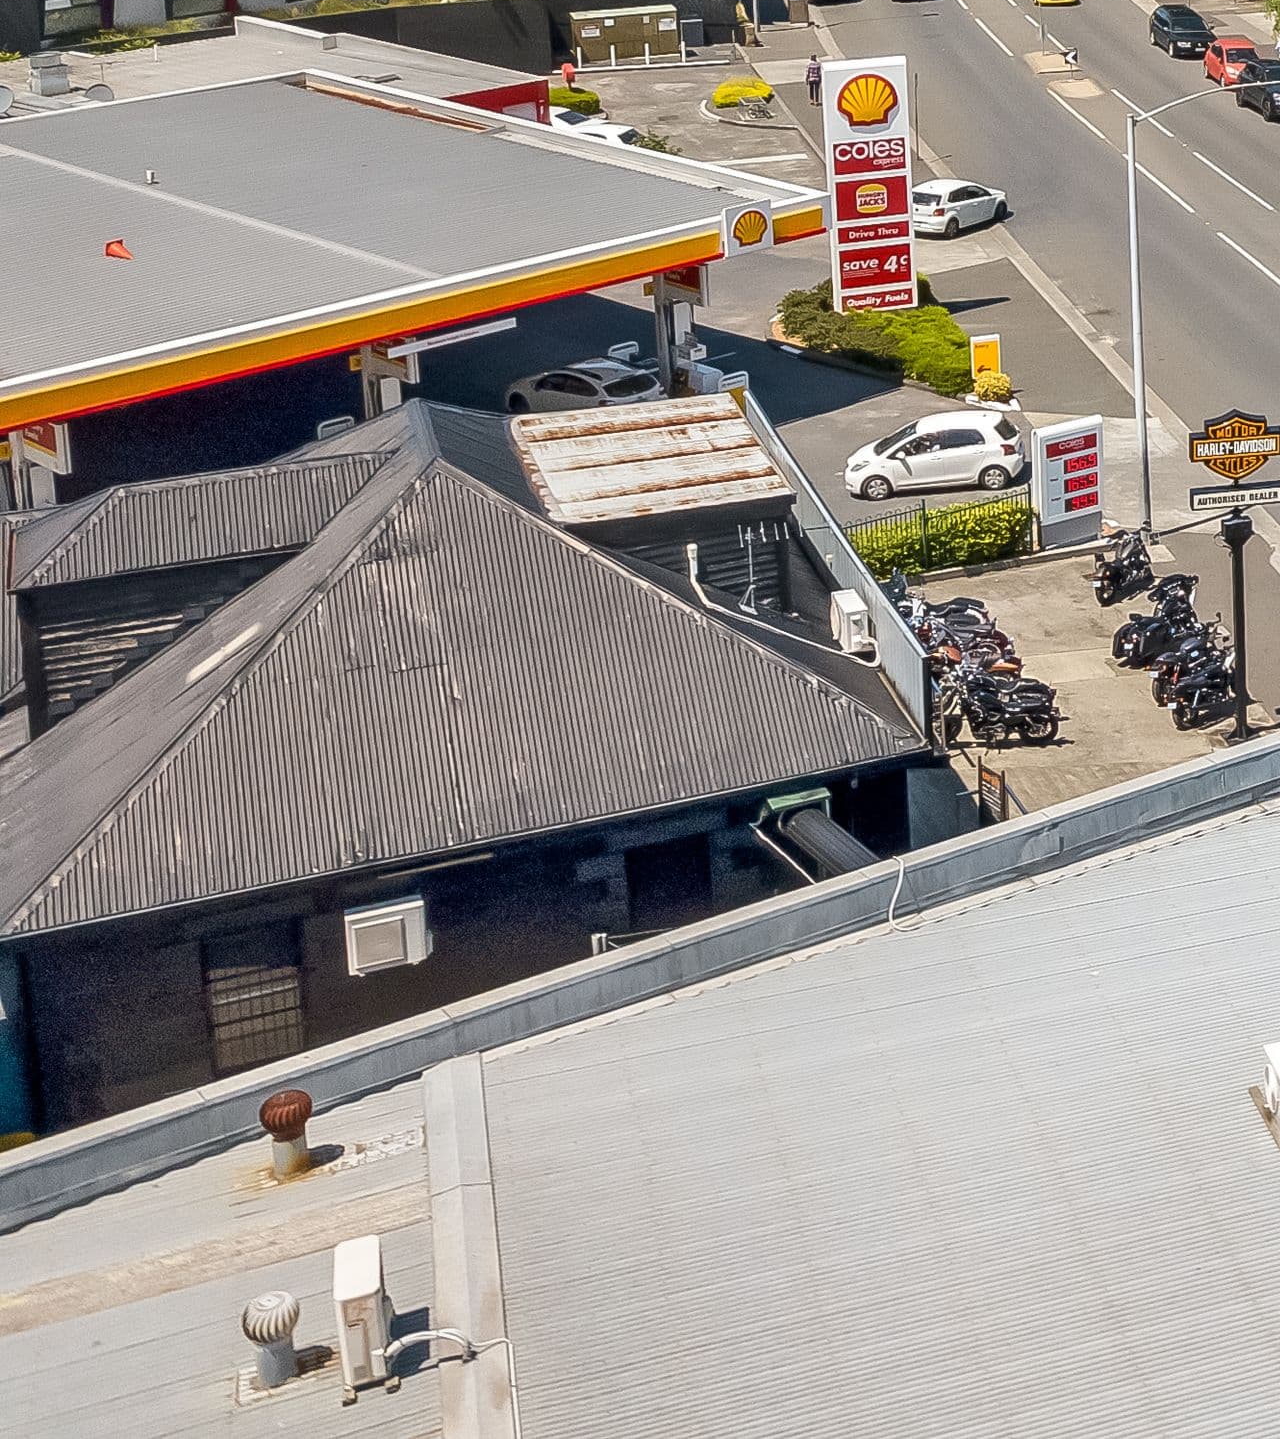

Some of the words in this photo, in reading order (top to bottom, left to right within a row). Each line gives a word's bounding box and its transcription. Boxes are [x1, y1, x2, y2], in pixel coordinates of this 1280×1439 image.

[835, 140, 905, 161] coles
[849, 229, 875, 239] Drive
[878, 227, 899, 236] Thru
[842, 259, 879, 271] save
[847, 296, 882, 307] Quality
[885, 292, 909, 303] Fuels
[1216, 422, 1257, 439] MOTOR
[1197, 438, 1277, 457] HARLEY-DAVIDSON
[1216, 456, 1257, 474] CYCLES
[1197, 494, 1246, 506] AUTHORISED
[1249, 491, 1278, 501] DEALER
